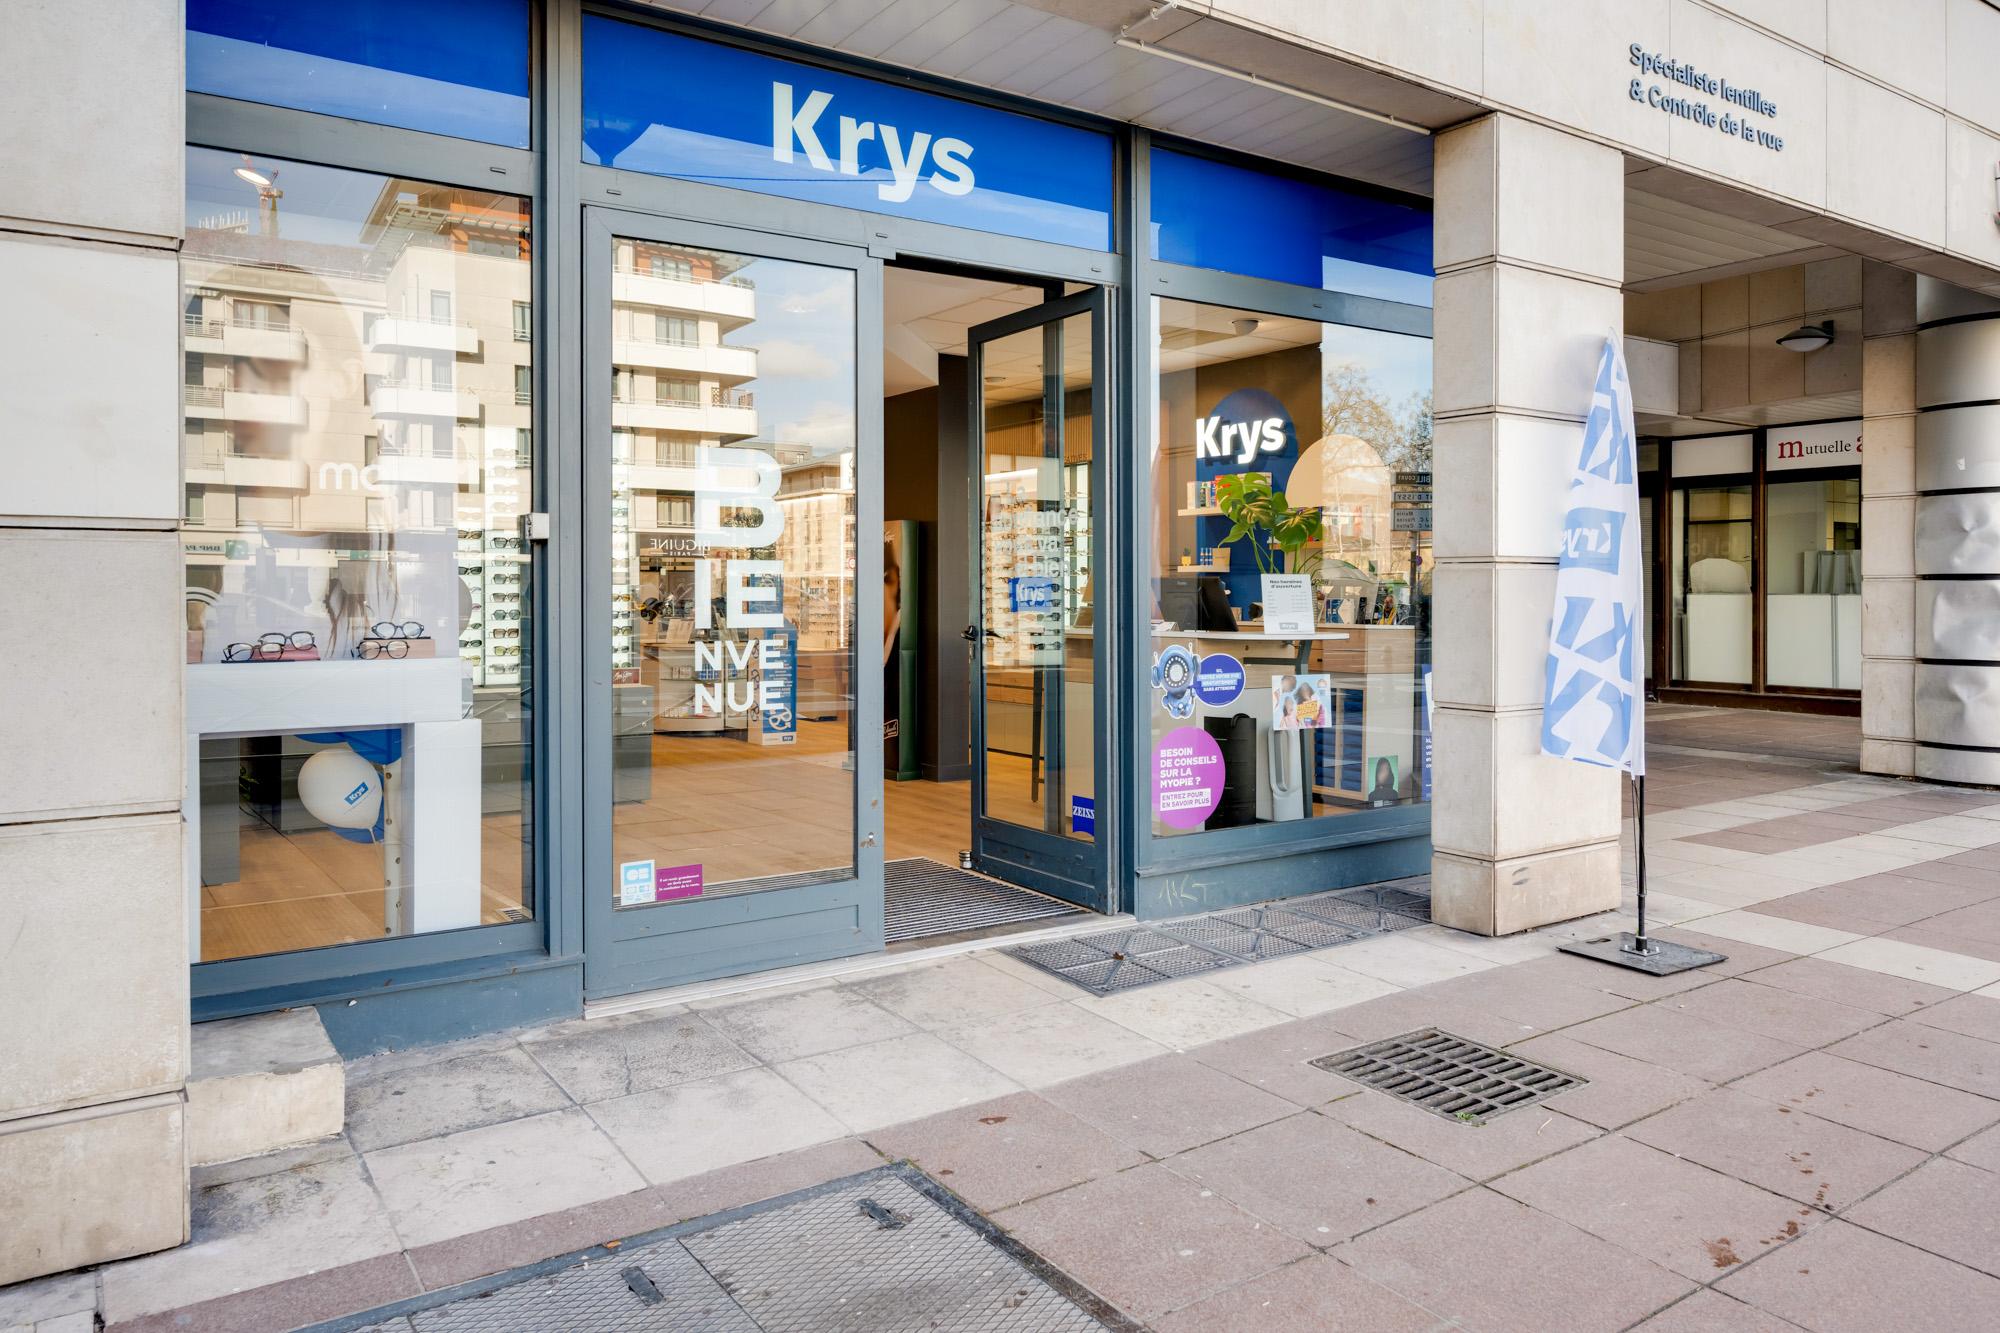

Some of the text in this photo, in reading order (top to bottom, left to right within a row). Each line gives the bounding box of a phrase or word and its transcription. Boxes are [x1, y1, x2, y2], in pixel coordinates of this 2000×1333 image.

[1629, 42, 1777, 118] Spécialiste lentilles
[1629, 79, 1784, 152] & Contrôle de la vue
[773, 81, 975, 203] Krys
[1196, 415, 1286, 465] Krys
[695, 639, 785, 671] NVE
[695, 681, 785, 714] NUE
[1160, 747, 1193, 758] BESOIN
[1160, 755, 1217, 768] DE CONSEILS
[1160, 767, 1192, 778] SUR LA
[1160, 776, 1201, 788] MYOPIE ?
[1162, 791, 1204, 801] ENTREZ POUR
[1171, 799, 1193, 808] SAVOIR
[1194, 797, 1210, 805] PLUS
[1073, 805, 1095, 820] ZEISS
